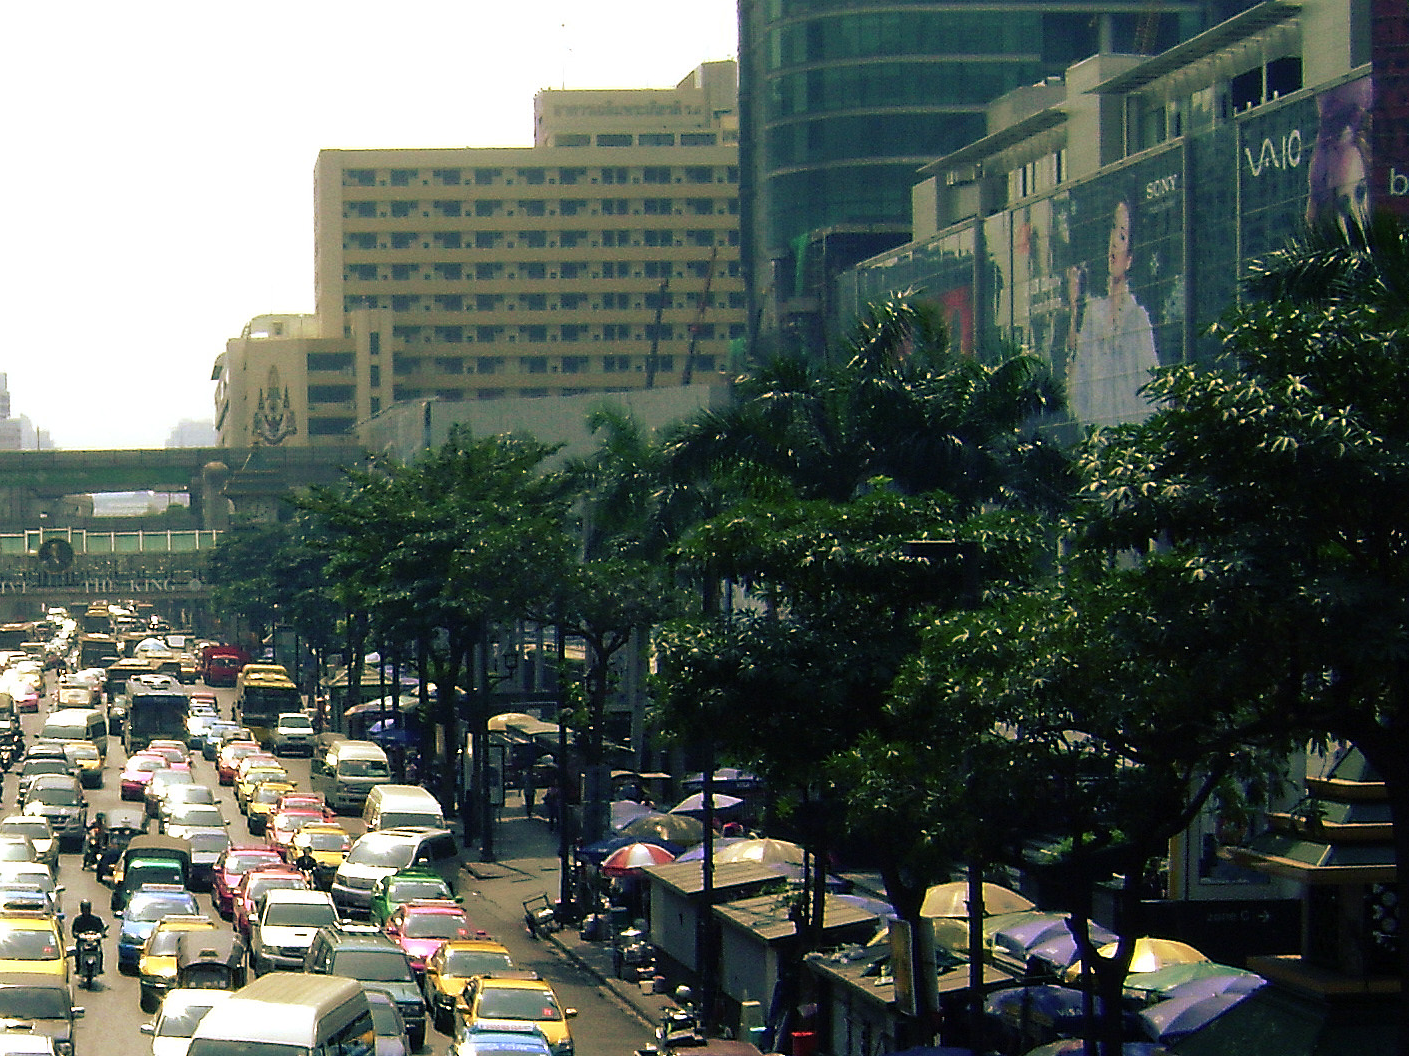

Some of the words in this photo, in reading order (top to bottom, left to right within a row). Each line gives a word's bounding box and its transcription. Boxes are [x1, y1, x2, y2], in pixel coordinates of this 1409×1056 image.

[1245, 129, 1301, 177] VAIO
[1146, 174, 1179, 200] SONY
[84, 577, 119, 594] THE
[129, 578, 176, 593] KING
